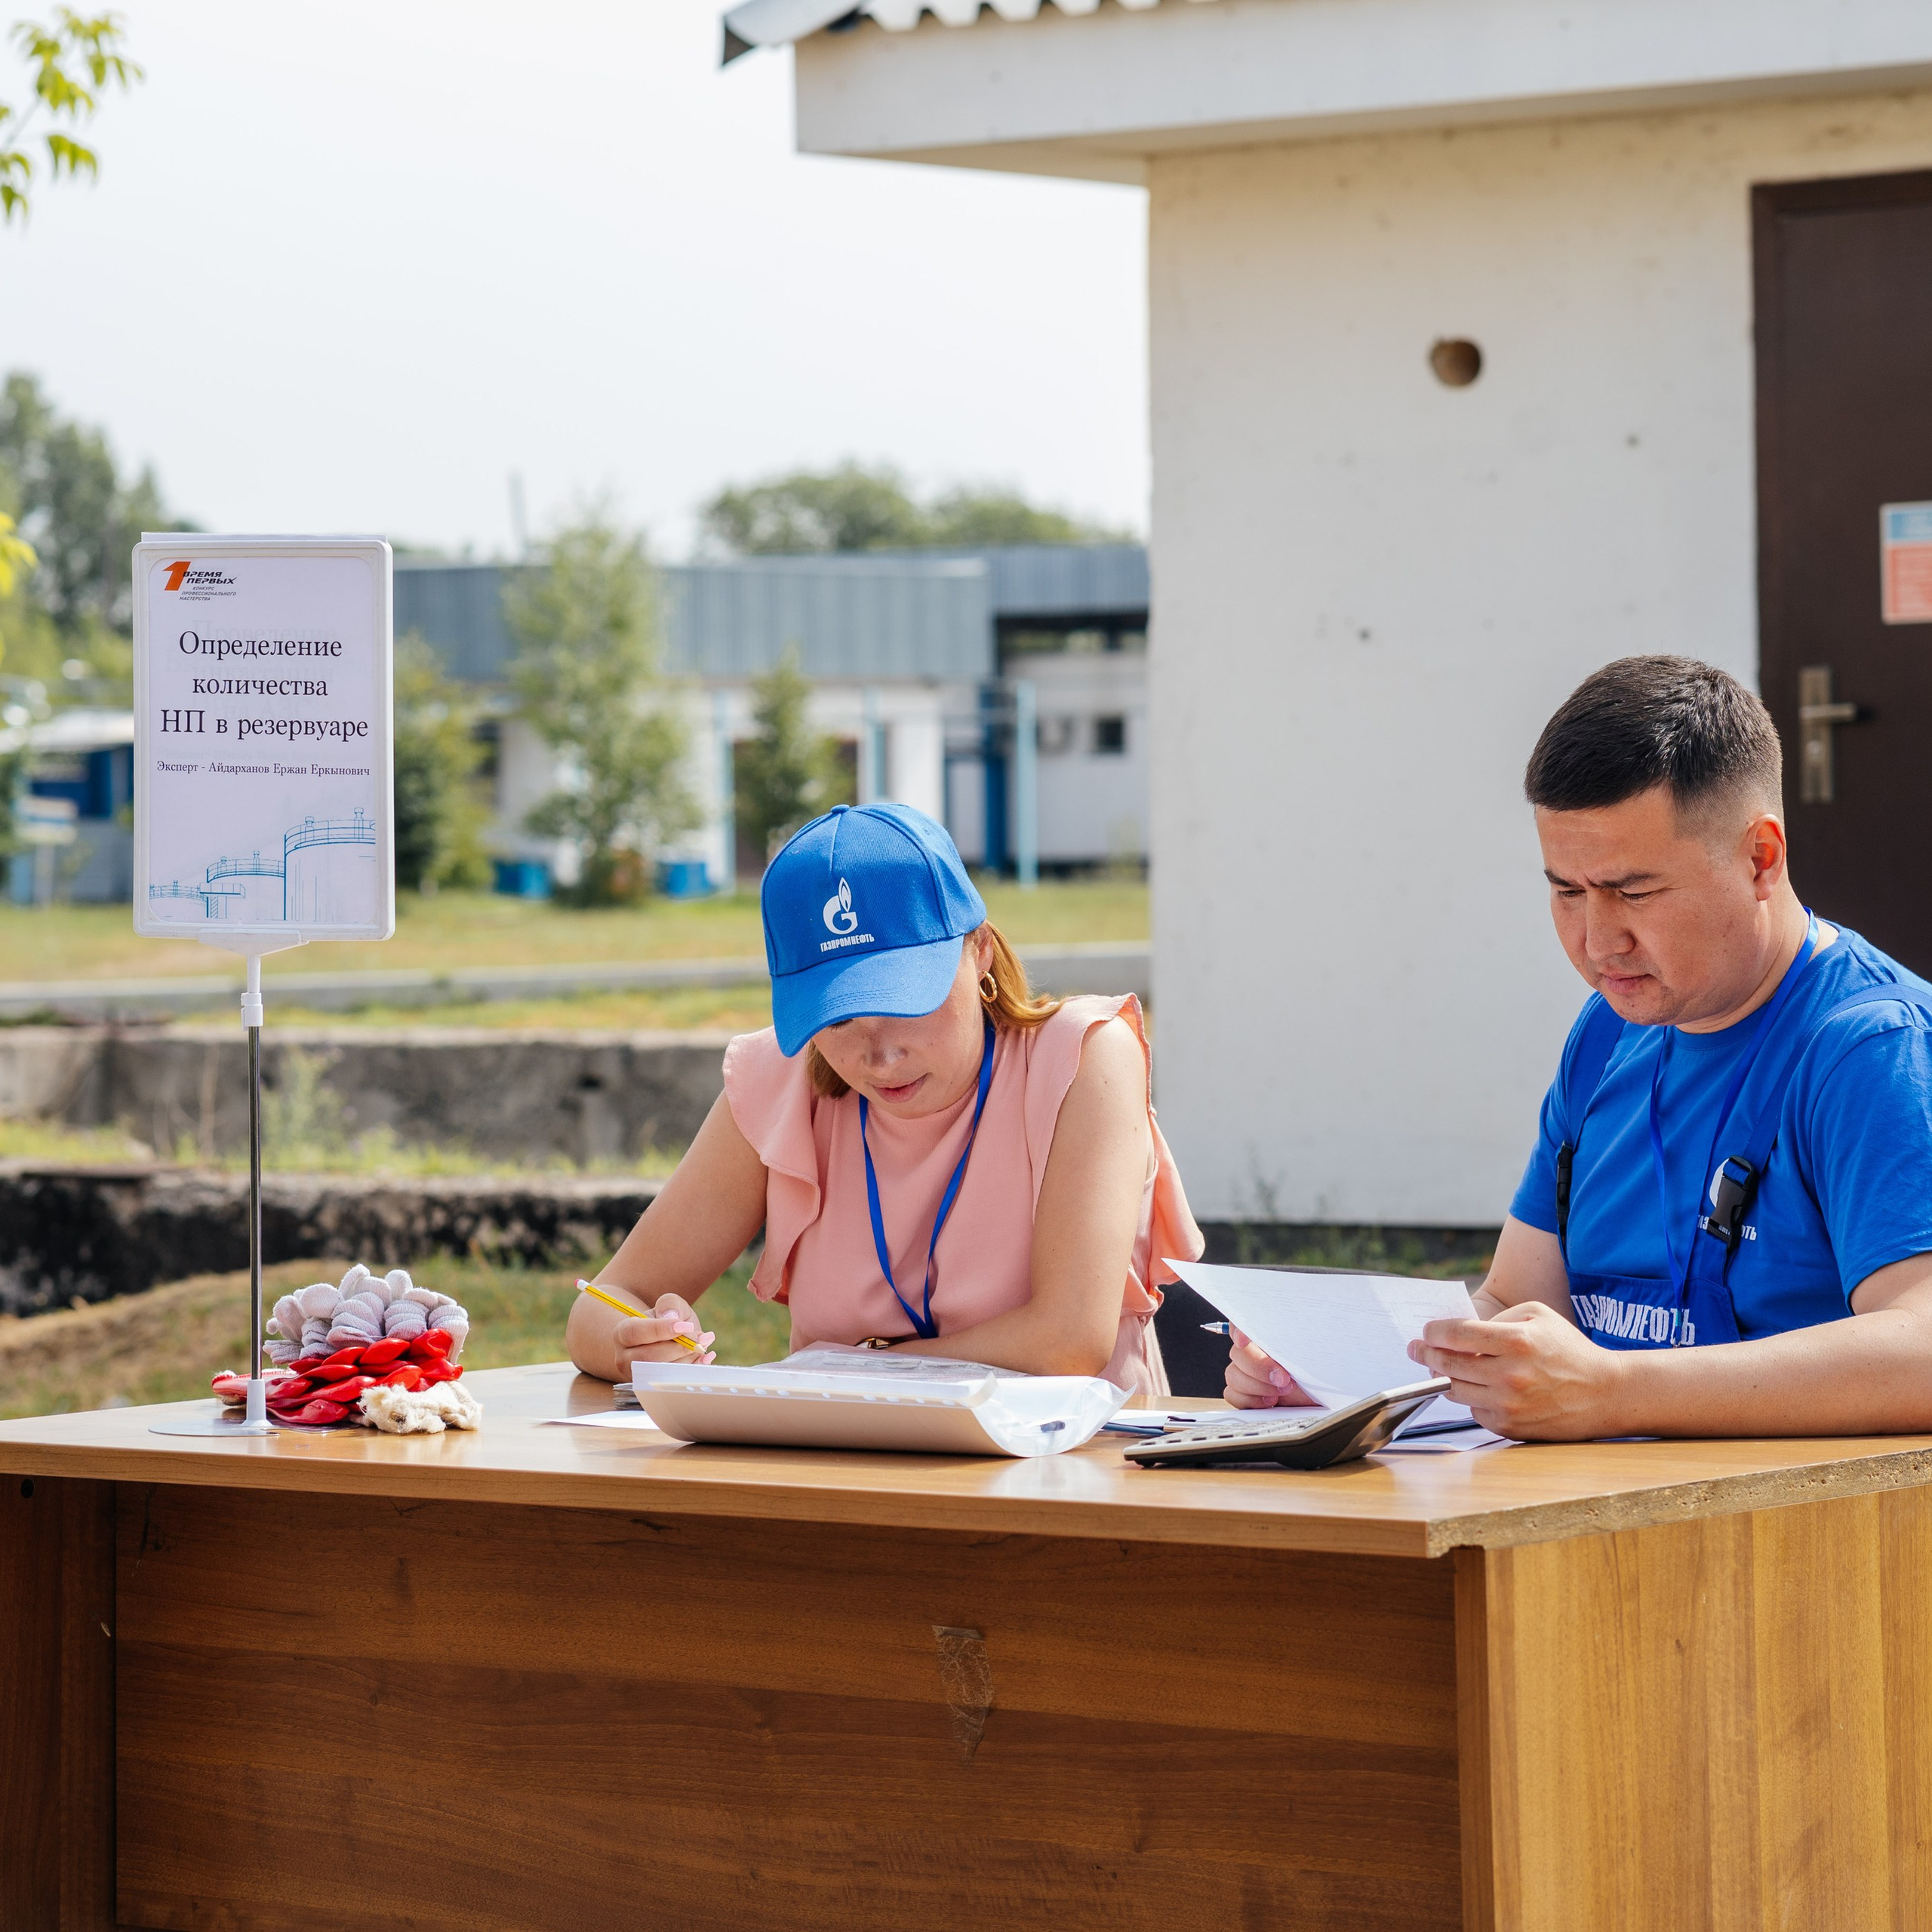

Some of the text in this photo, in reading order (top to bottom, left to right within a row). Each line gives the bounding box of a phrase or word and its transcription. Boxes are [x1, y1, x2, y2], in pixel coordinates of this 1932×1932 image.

[179, 630, 343, 661] Определение
[192, 678, 329, 697] количества
[160, 709, 206, 734] НП
[216, 718, 229, 734] в
[237, 717, 368, 743] резервуаре
[157, 760, 198, 774] Эксперт
[208, 761, 269, 776] Айдарханов
[273, 763, 307, 777] Ержан
[311, 764, 370, 778] Еркынович
[820, 934, 875, 952] ГАЗПРОМНЕФТЬ
